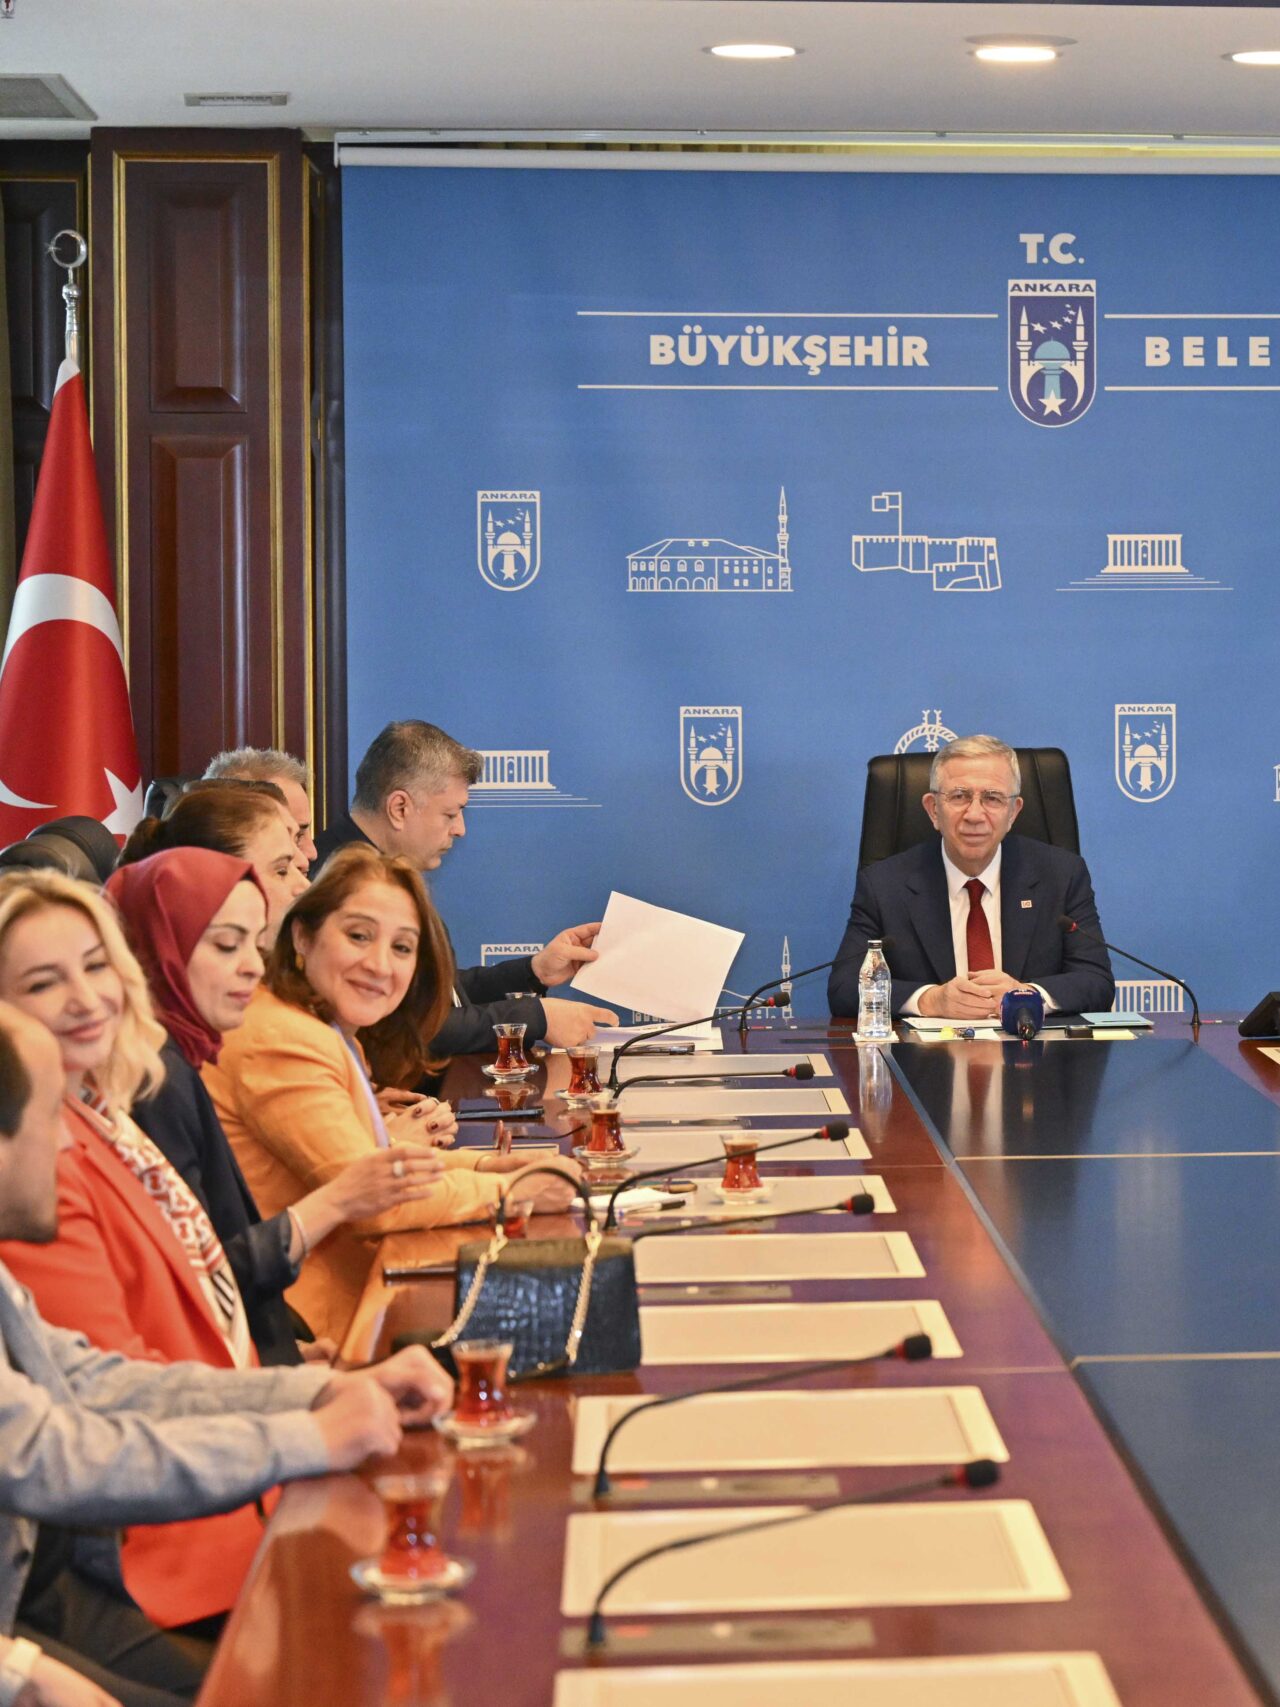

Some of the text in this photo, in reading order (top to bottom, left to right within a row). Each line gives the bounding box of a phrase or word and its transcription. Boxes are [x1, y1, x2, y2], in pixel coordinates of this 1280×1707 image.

[1019, 232, 1085, 265] T.C.
[1010, 283, 1094, 293] ANKARA
[649, 325, 930, 376] BÜYÜKŞEHİR
